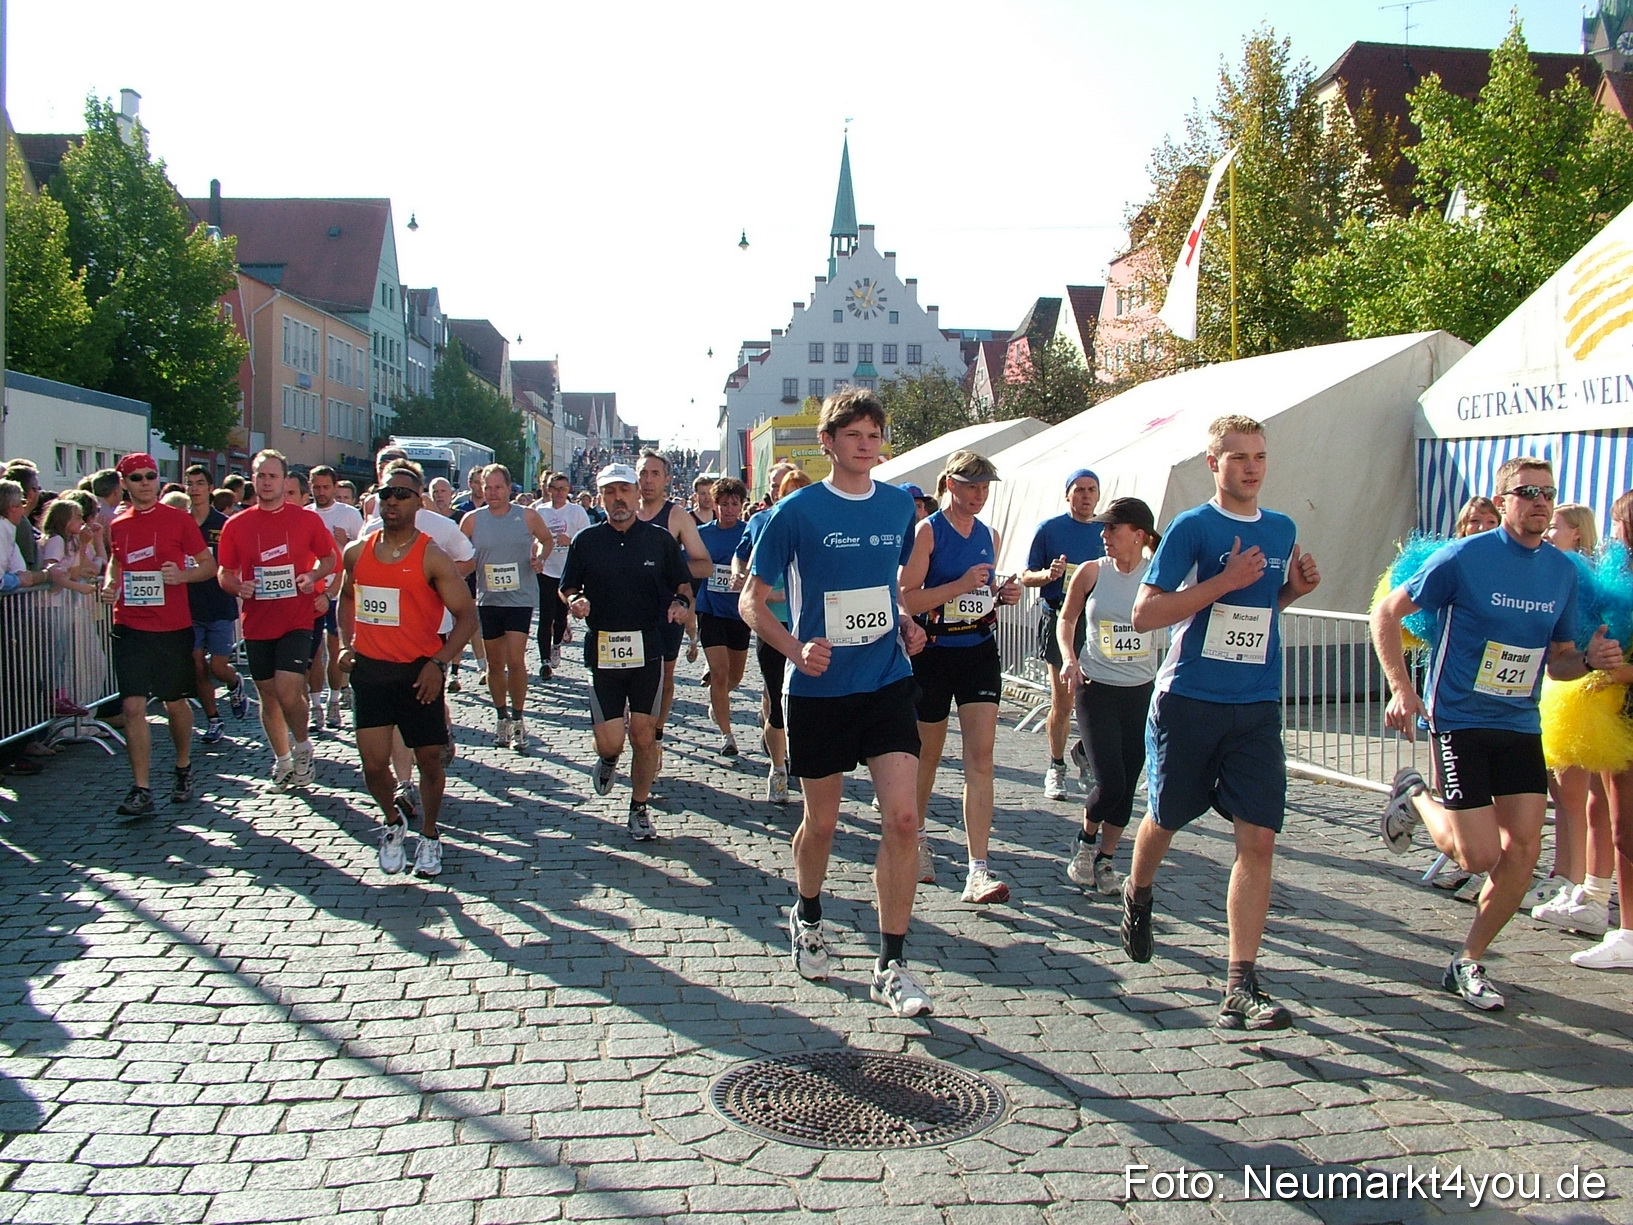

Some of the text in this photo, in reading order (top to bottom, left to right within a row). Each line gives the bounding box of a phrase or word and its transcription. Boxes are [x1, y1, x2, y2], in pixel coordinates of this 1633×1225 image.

[1457, 382, 1568, 421] GETRÄNKE
[831, 535, 861, 545] Fischer
[265, 578, 293, 591] 2508
[494, 575, 512, 585] 513
[133, 585, 160, 597] 2507
[364, 599, 387, 614] 999
[959, 600, 983, 614] 638
[1490, 592, 1555, 614] Sinupret
[845, 611, 888, 630] 3628
[1232, 612, 1260, 622] Michael
[1113, 624, 1137, 633] Gabri
[608, 635, 632, 643] Ludwig
[1103, 636, 1110, 644] C
[1115, 638, 1141, 651] 443
[1225, 630, 1264, 648] 3537
[610, 646, 634, 659] 164
[1500, 650, 1531, 663] Harald
[1484, 660, 1493, 670] B
[1496, 667, 1526, 684] 421
